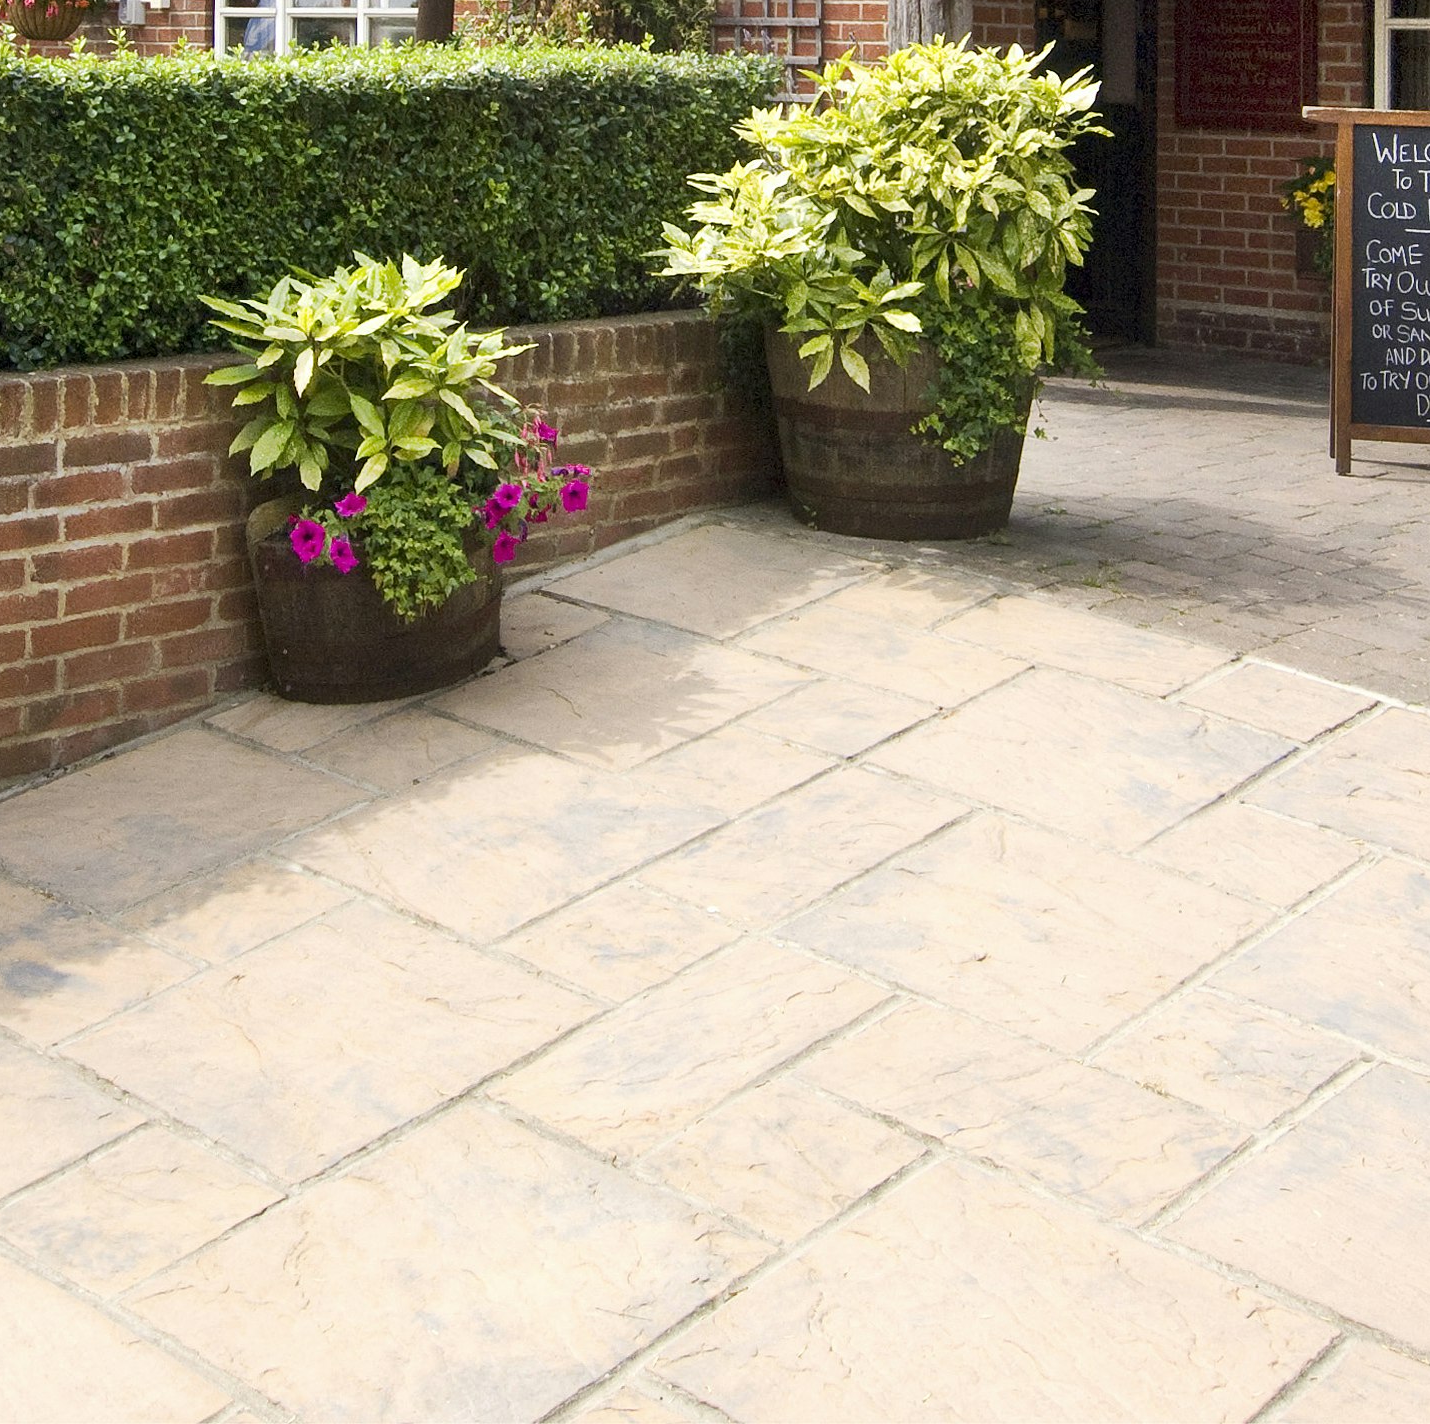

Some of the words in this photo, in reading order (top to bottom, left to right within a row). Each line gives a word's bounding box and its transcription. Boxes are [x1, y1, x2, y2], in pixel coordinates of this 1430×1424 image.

[1367, 193, 1417, 219] COLD
[1366, 240, 1423, 265] COME
[1362, 268, 1392, 292] TRY
[1370, 300, 1394, 317] OF
[1372, 325, 1393, 340] OR
[1386, 348, 1415, 366] AND
[1383, 370, 1411, 390] TRY
